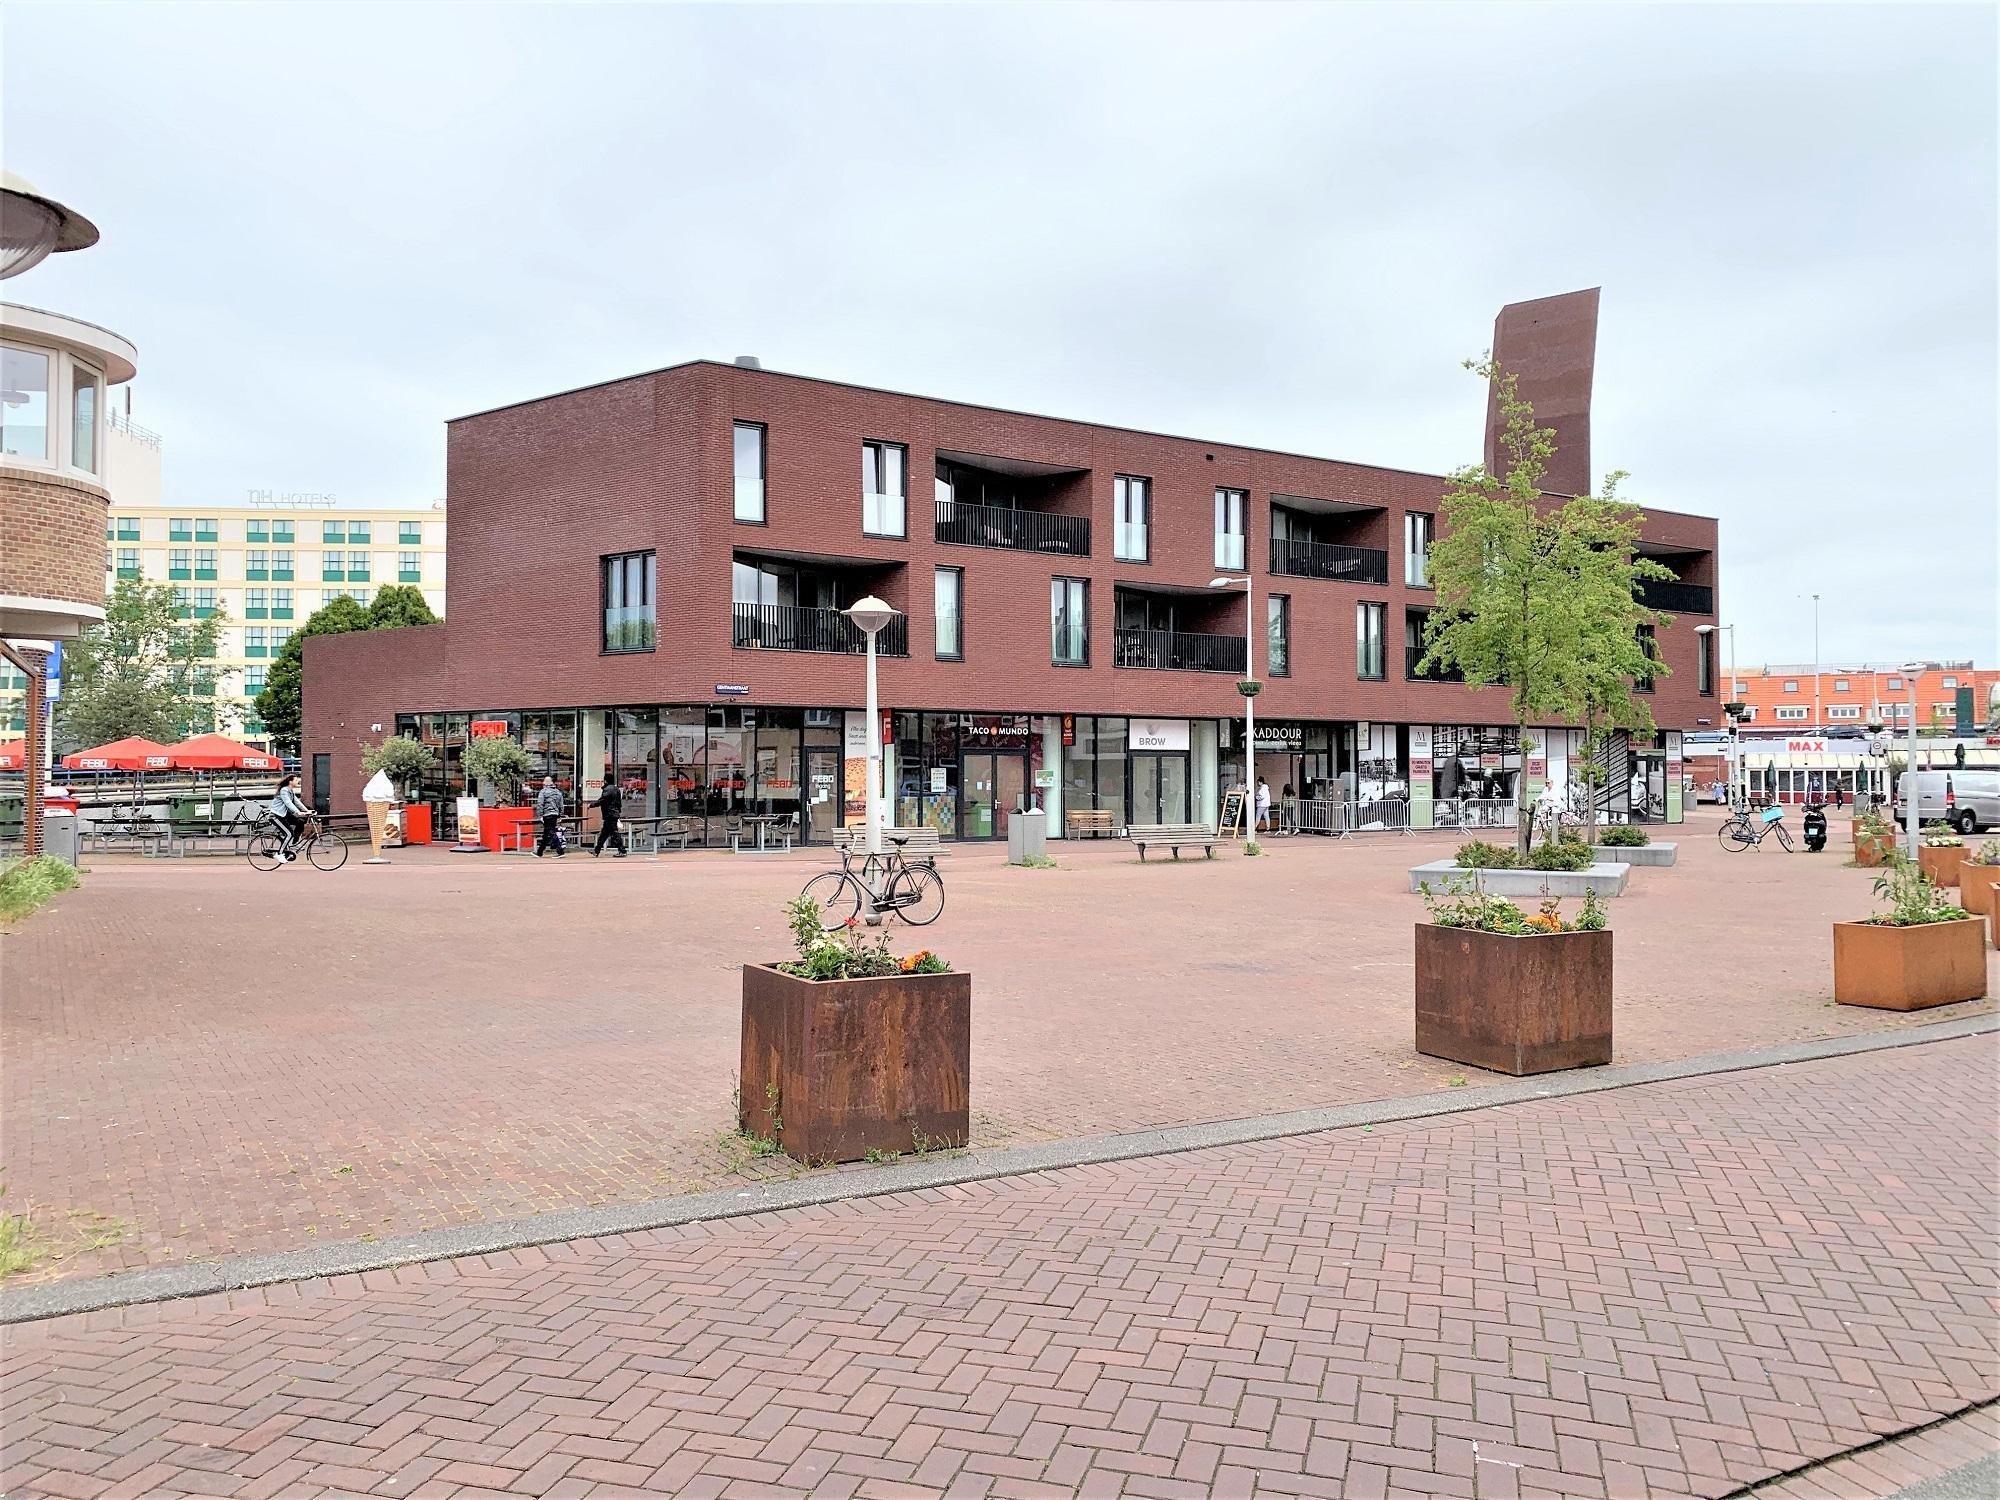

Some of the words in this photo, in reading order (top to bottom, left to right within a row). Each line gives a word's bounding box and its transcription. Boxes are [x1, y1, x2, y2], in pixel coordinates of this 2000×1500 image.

[281, 493, 336, 504] HOTELS
[968, 727, 990, 735] TACO
[998, 727, 1029, 736] MUNDO
[1138, 737, 1166, 746] BROW
[1788, 741, 1824, 751] MAX
[80, 758, 107, 768] FEBO
[146, 757, 168, 766] FEBO
[242, 757, 269, 768] FEBO
[812, 775, 834, 783] FEBO
[586, 780, 605, 789] FEB
